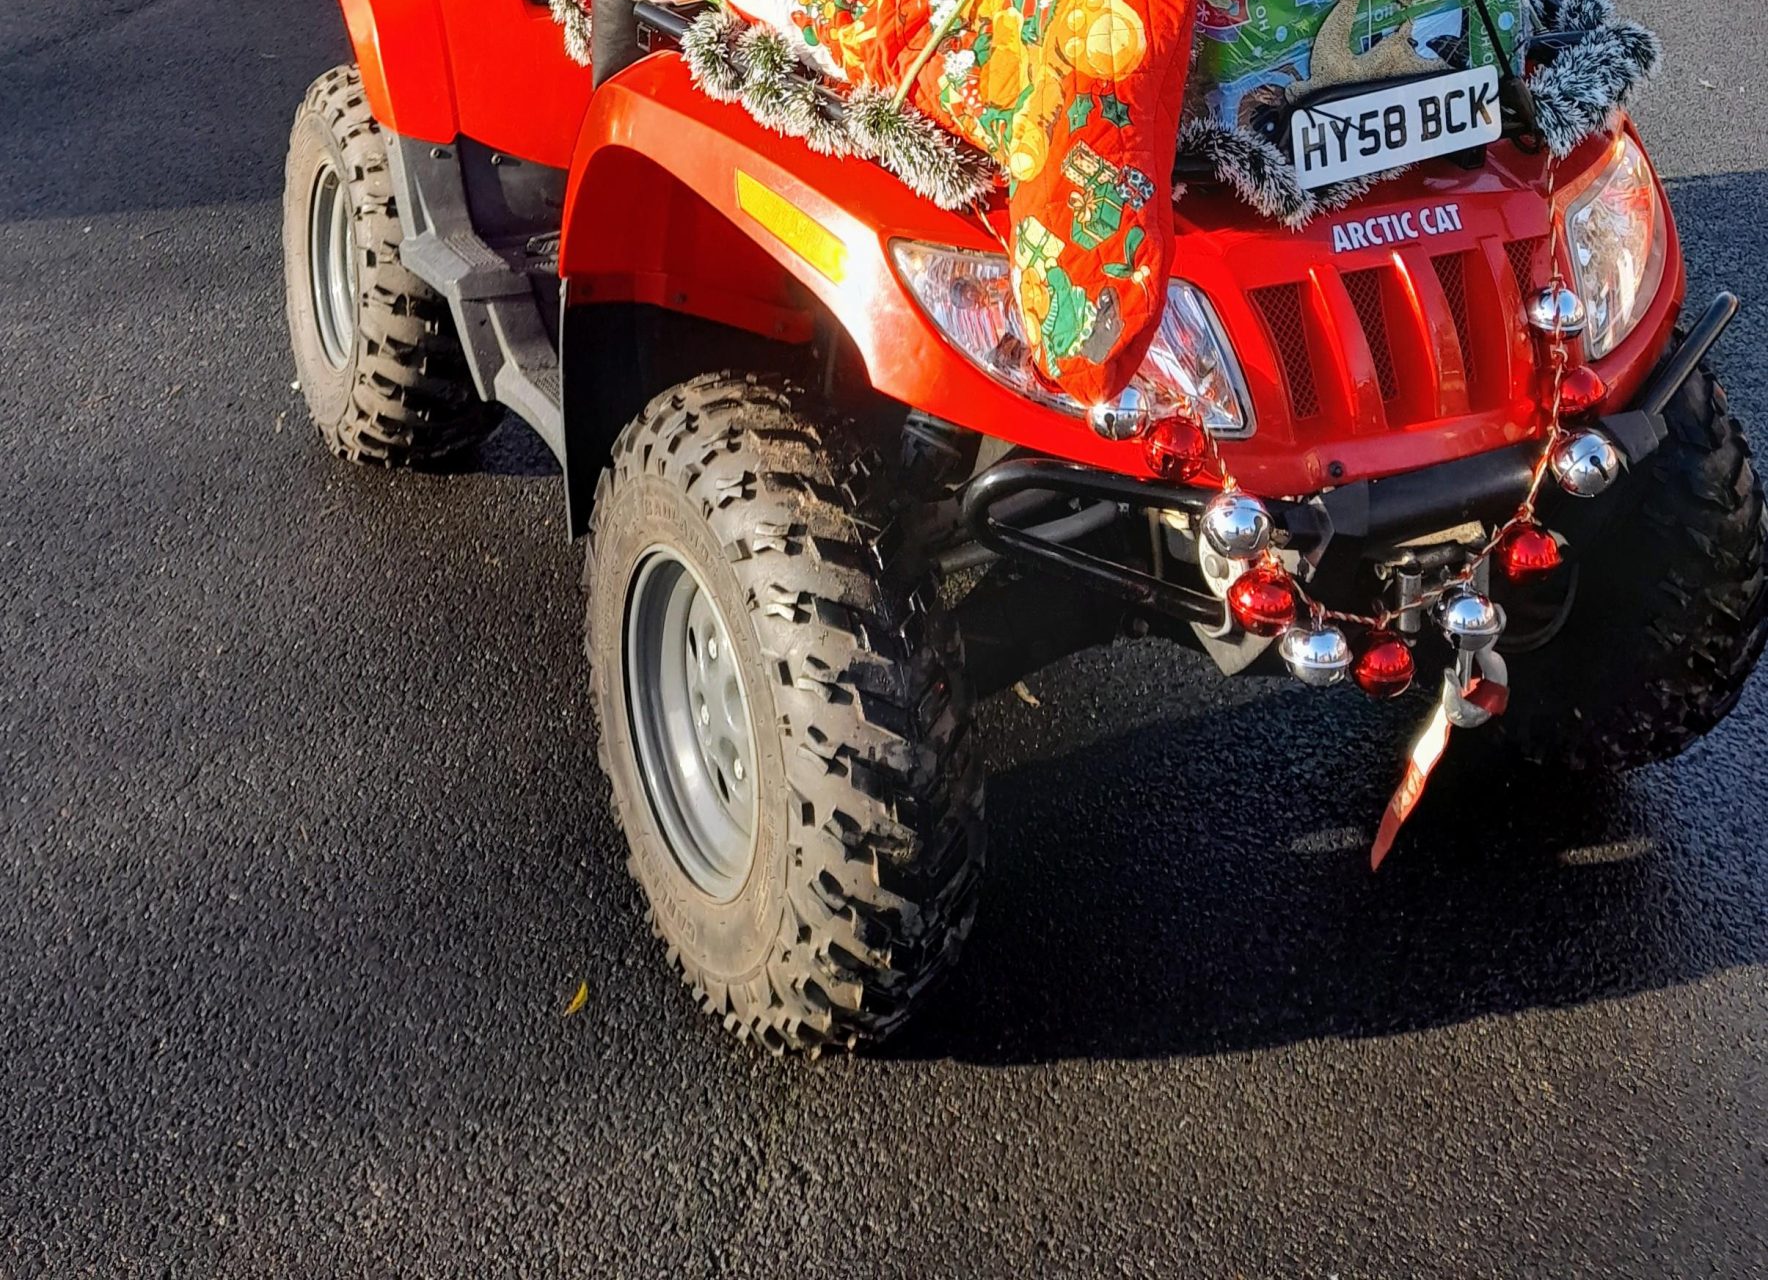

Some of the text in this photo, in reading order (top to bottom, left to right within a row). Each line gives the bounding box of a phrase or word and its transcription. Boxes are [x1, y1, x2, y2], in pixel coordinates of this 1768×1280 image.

[1255, 6, 1271, 31] HO
[1302, 82, 1493, 171] HY58 BCK
[1332, 203, 1463, 253] ARCTIC CAT
